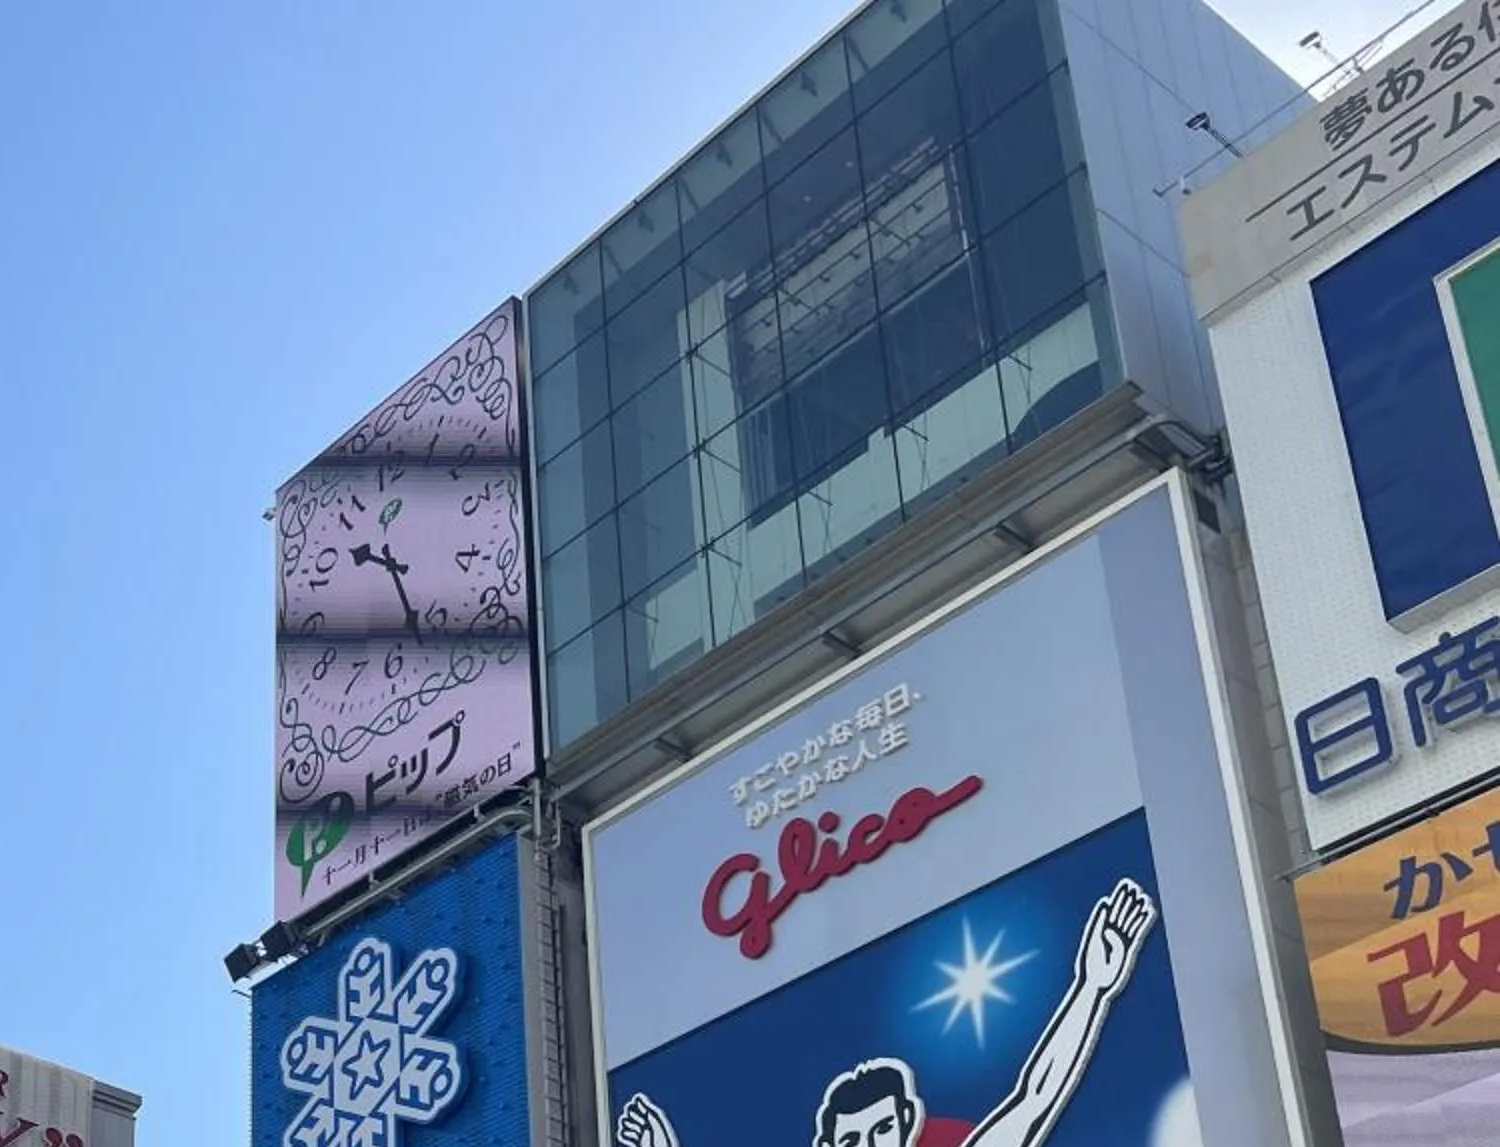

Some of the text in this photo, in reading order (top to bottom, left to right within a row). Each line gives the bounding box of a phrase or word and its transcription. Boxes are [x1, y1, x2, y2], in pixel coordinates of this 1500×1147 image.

[1287, 80, 1500, 240] エステム
[308, 547, 339, 592] 10
[454, 543, 482, 572] 4
[312, 647, 338, 681] 8
[345, 659, 371, 695] 7
[384, 642, 404, 679] 6
[1295, 614, 1500, 795] 日商
[365, 711, 465, 815] ピップ
[729, 682, 924, 803] すこやかな毎日、
[745, 722, 910, 829] ゆたかな人生
